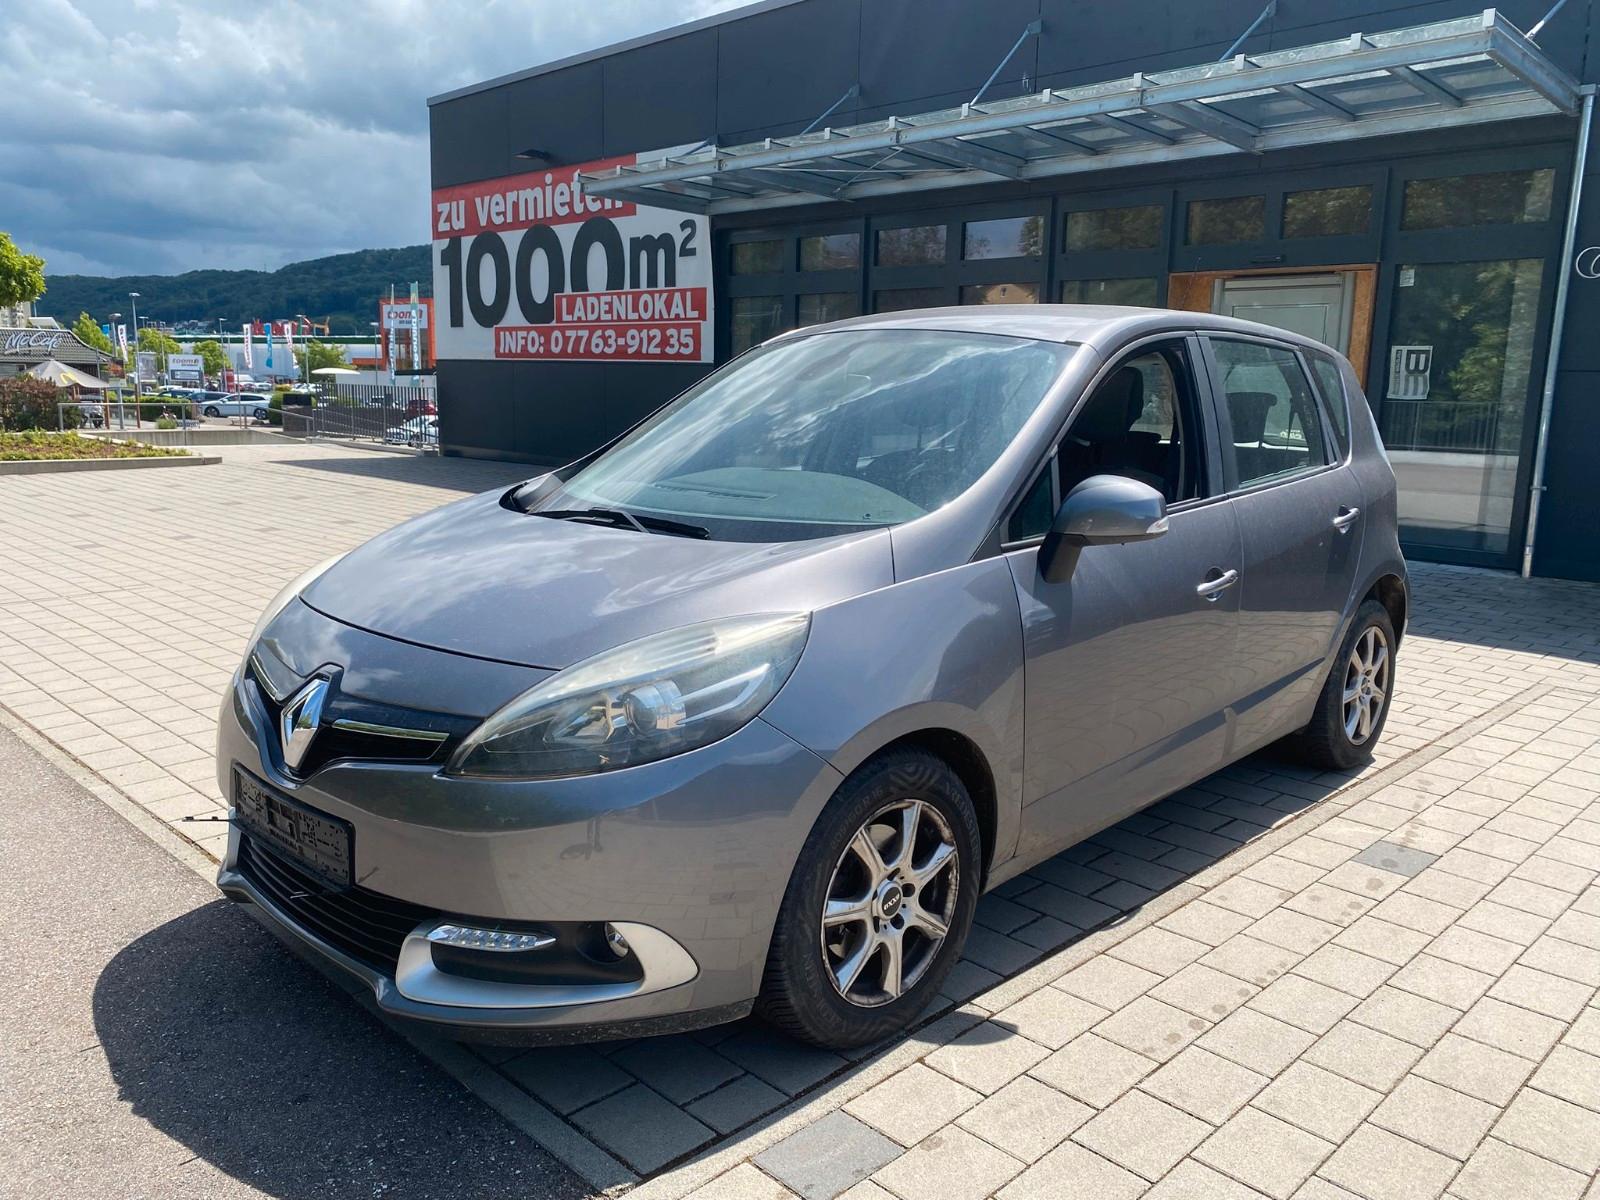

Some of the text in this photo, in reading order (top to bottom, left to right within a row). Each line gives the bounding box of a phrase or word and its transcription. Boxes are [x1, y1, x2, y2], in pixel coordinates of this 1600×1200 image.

[437, 199, 466, 232] zu
[561, 291, 699, 322] LADENLOKAL
[499, 329, 545, 354] INFO:
